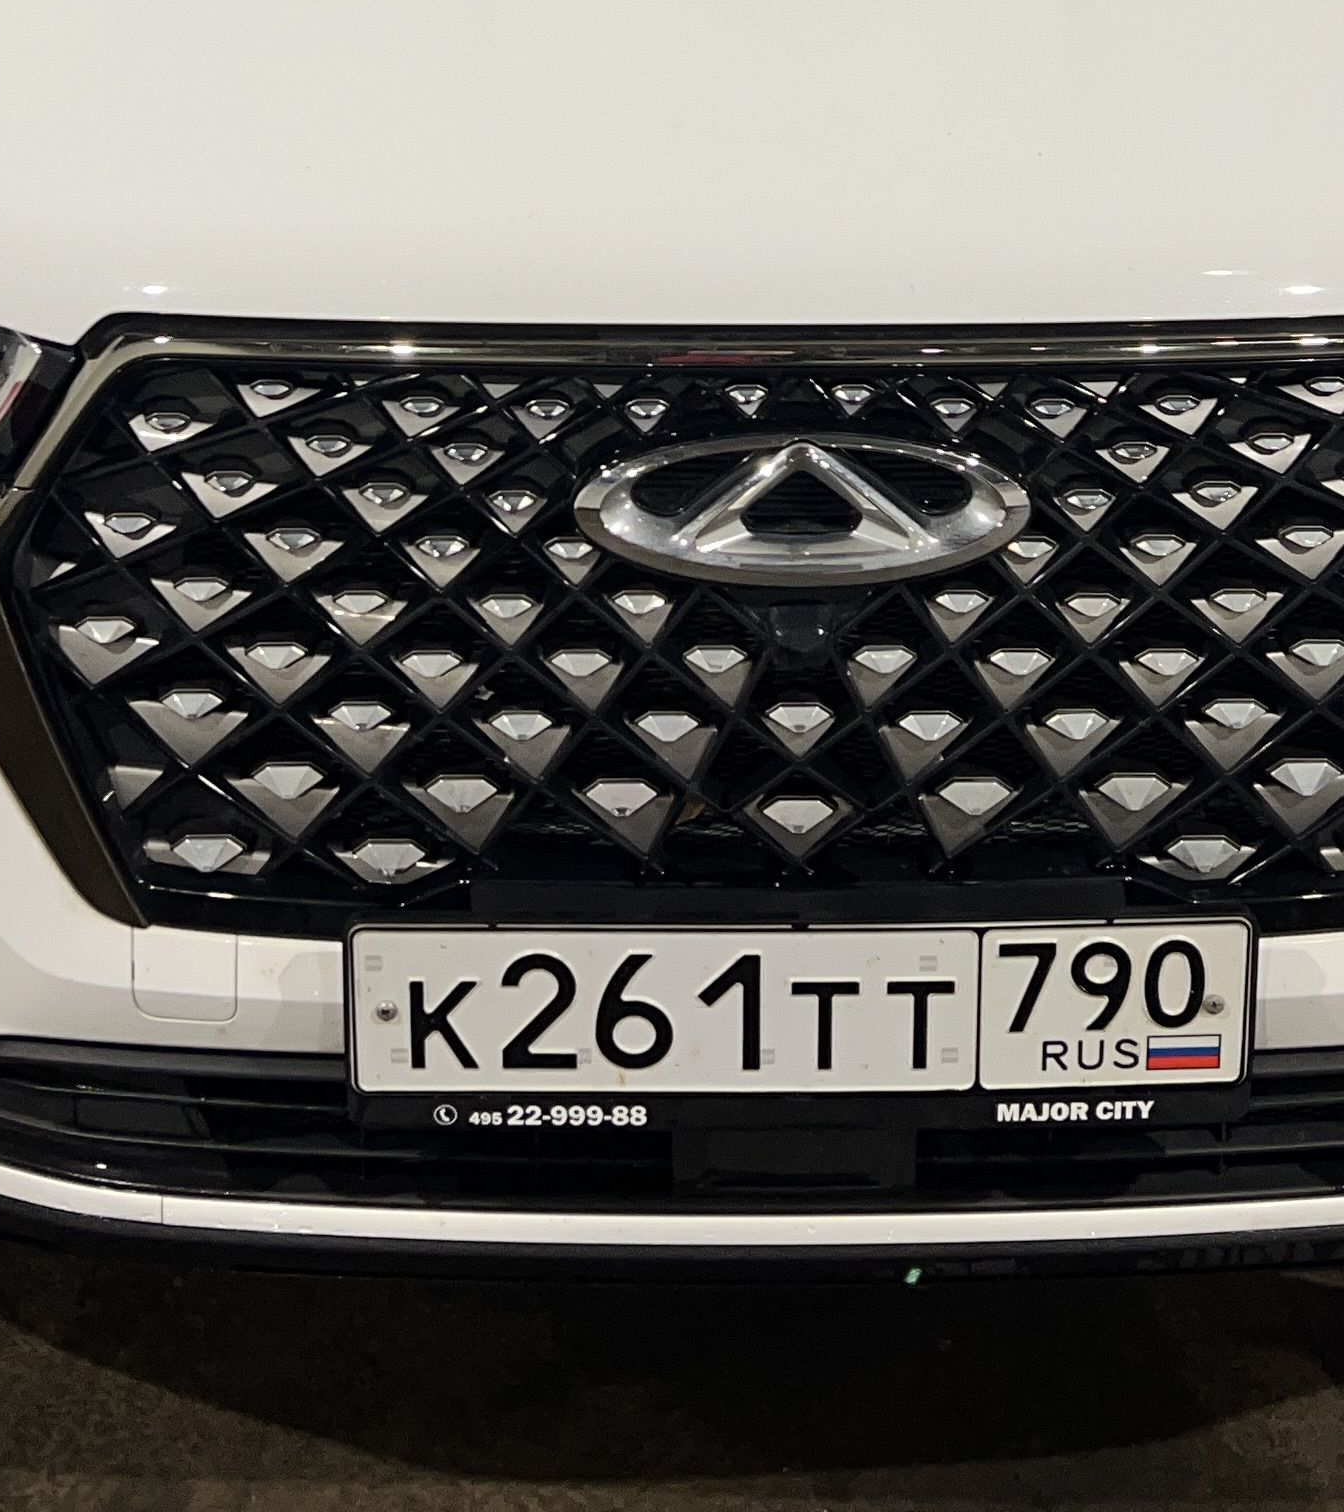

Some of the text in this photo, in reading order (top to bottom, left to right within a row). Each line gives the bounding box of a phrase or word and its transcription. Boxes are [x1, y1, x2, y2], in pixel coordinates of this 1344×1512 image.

[997, 938, 1207, 1034] 790
[1040, 1037, 1141, 1073] RUS
[468, 1104, 648, 1127] 495 22-999-88
[995, 1099, 1155, 1123] MAJOR CITY
